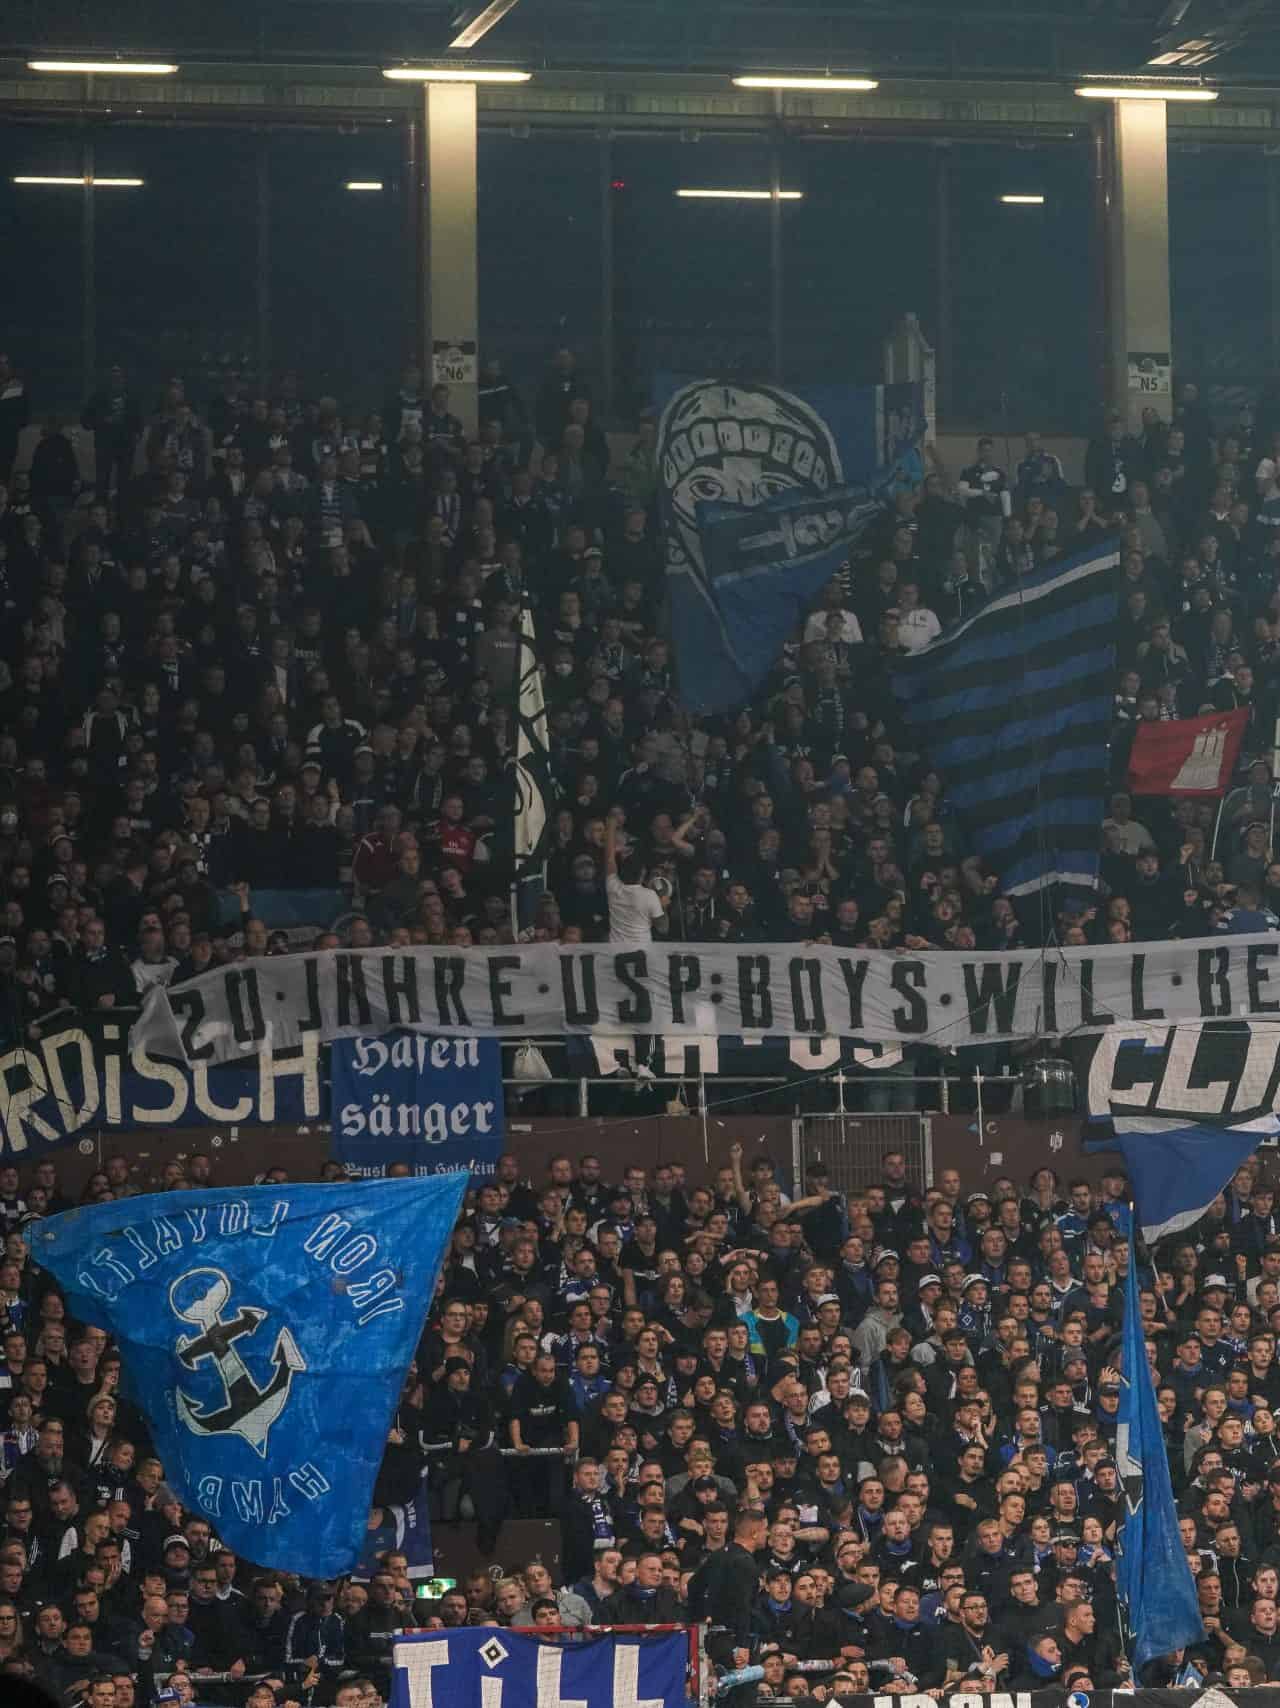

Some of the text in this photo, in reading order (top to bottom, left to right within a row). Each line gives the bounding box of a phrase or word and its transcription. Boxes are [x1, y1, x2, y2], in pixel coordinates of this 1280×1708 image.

[298, 955, 525, 1031] JAHRE
[963, 953, 1164, 1034] WILL
[1198, 943, 1280, 1017] BE
[0, 1020, 320, 1153] RDiSCH
[340, 1094, 495, 1144] sänger
